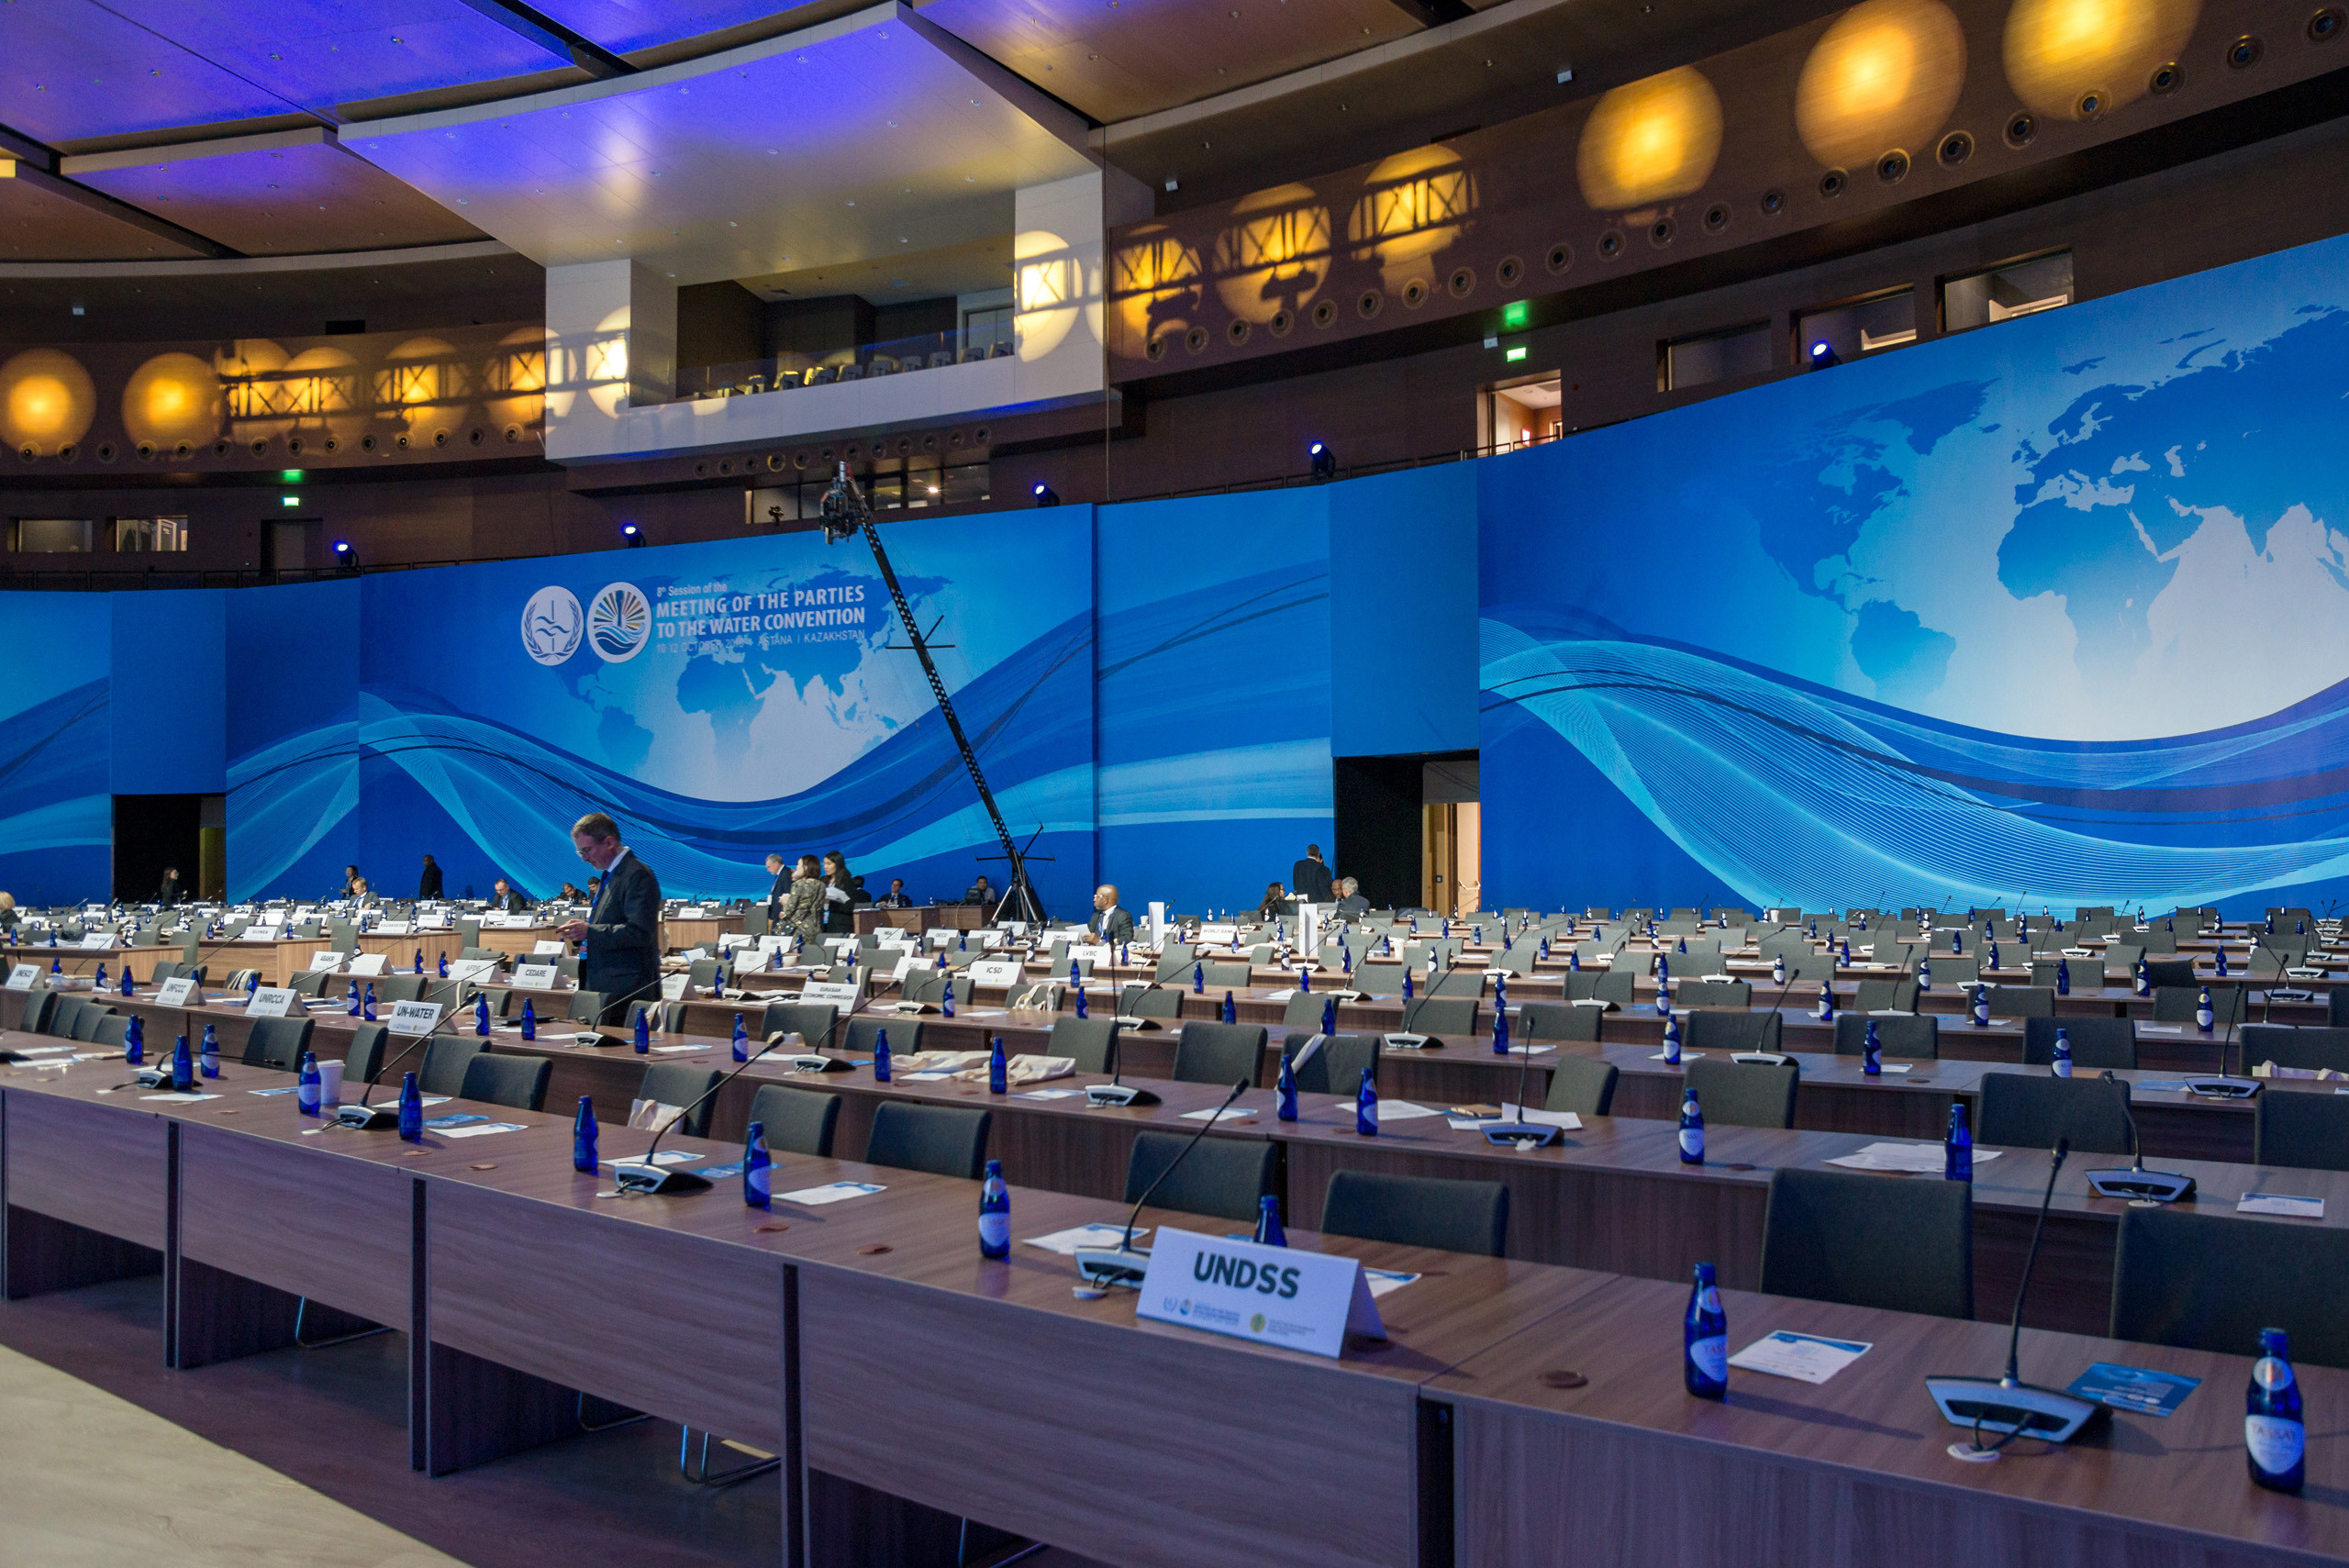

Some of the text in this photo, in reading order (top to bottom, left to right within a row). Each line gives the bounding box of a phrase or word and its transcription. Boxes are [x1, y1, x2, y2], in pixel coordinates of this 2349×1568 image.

[668, 584, 701, 596] Session
[703, 582, 712, 594] of
[713, 582, 728, 592] the
[656, 585, 865, 618] MEETING OF THE PARTIES
[656, 606, 865, 639] TO THE WATER CONVENTION
[758, 634, 793, 647] ASTANA
[804, 628, 865, 643] KAZAKHSTAN
[525, 969, 547, 977] CEDARE
[166, 983, 187, 994] UNFCCC
[258, 993, 285, 1005] UNRCCA
[396, 1005, 435, 1020] UN-WATER
[1194, 1251, 1302, 1300] UNDSS
